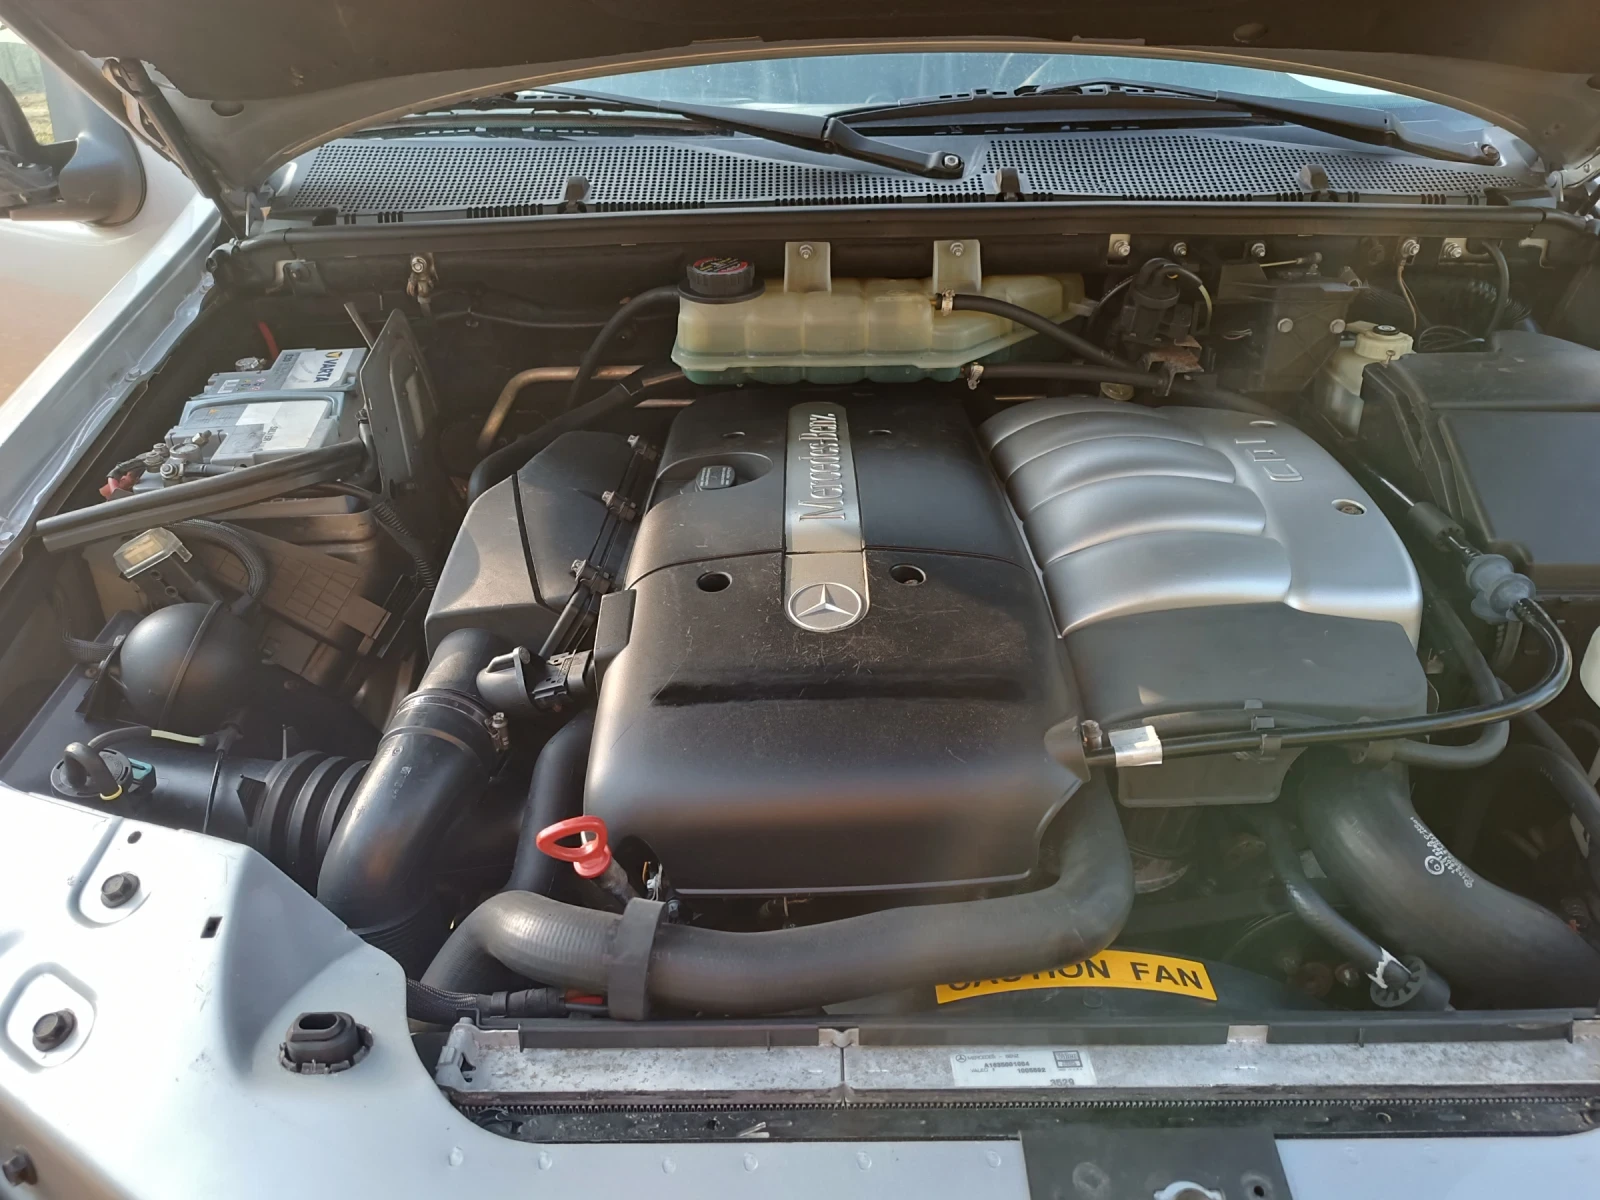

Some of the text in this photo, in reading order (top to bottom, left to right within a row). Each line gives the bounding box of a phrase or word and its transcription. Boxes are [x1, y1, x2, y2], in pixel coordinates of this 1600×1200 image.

[313, 358, 339, 382] VARTA
[798, 413, 846, 521] Mercedes-Benz
[1130, 961, 1203, 990] FAN
